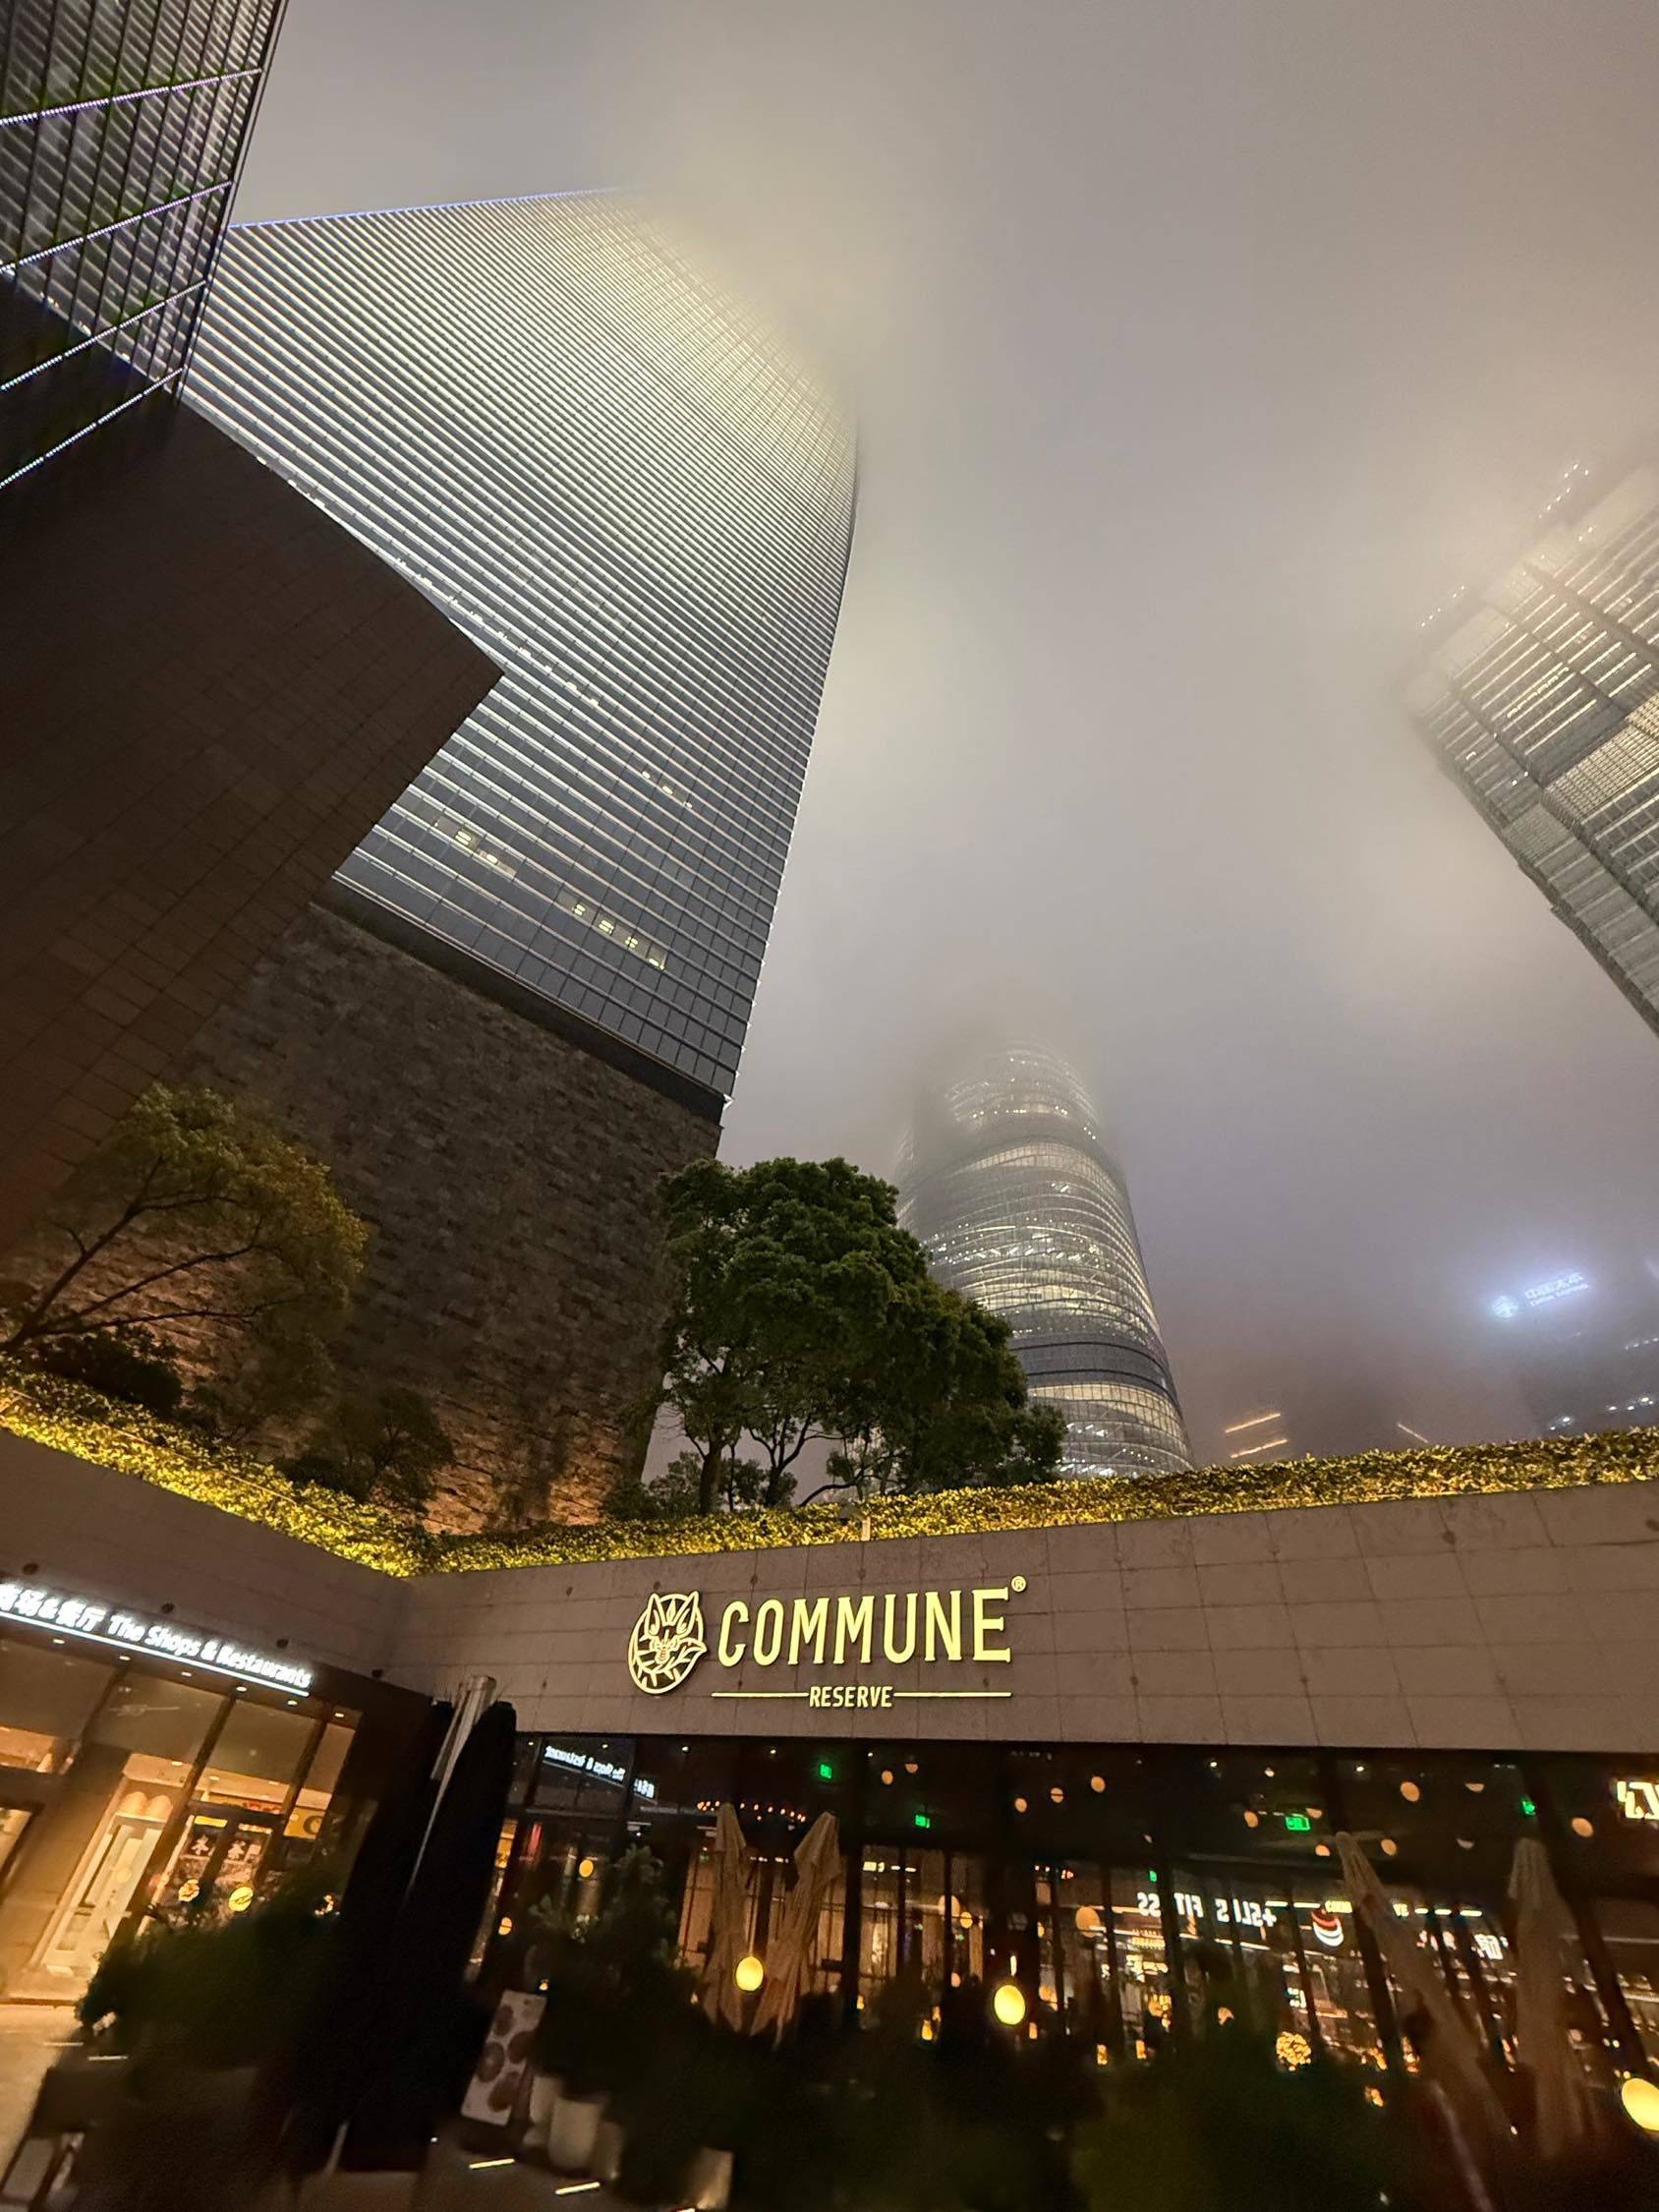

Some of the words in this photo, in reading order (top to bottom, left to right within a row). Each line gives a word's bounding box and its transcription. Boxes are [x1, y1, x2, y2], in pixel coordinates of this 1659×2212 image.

[107, 1614, 145, 1642] The
[144, 1625, 201, 1657] Shops
[200, 1639, 220, 1661] &
[216, 1644, 312, 1689] Restaurants
[717, 1587, 1011, 1667] COMMUNE
[809, 1685, 893, 1708] RESERVE
